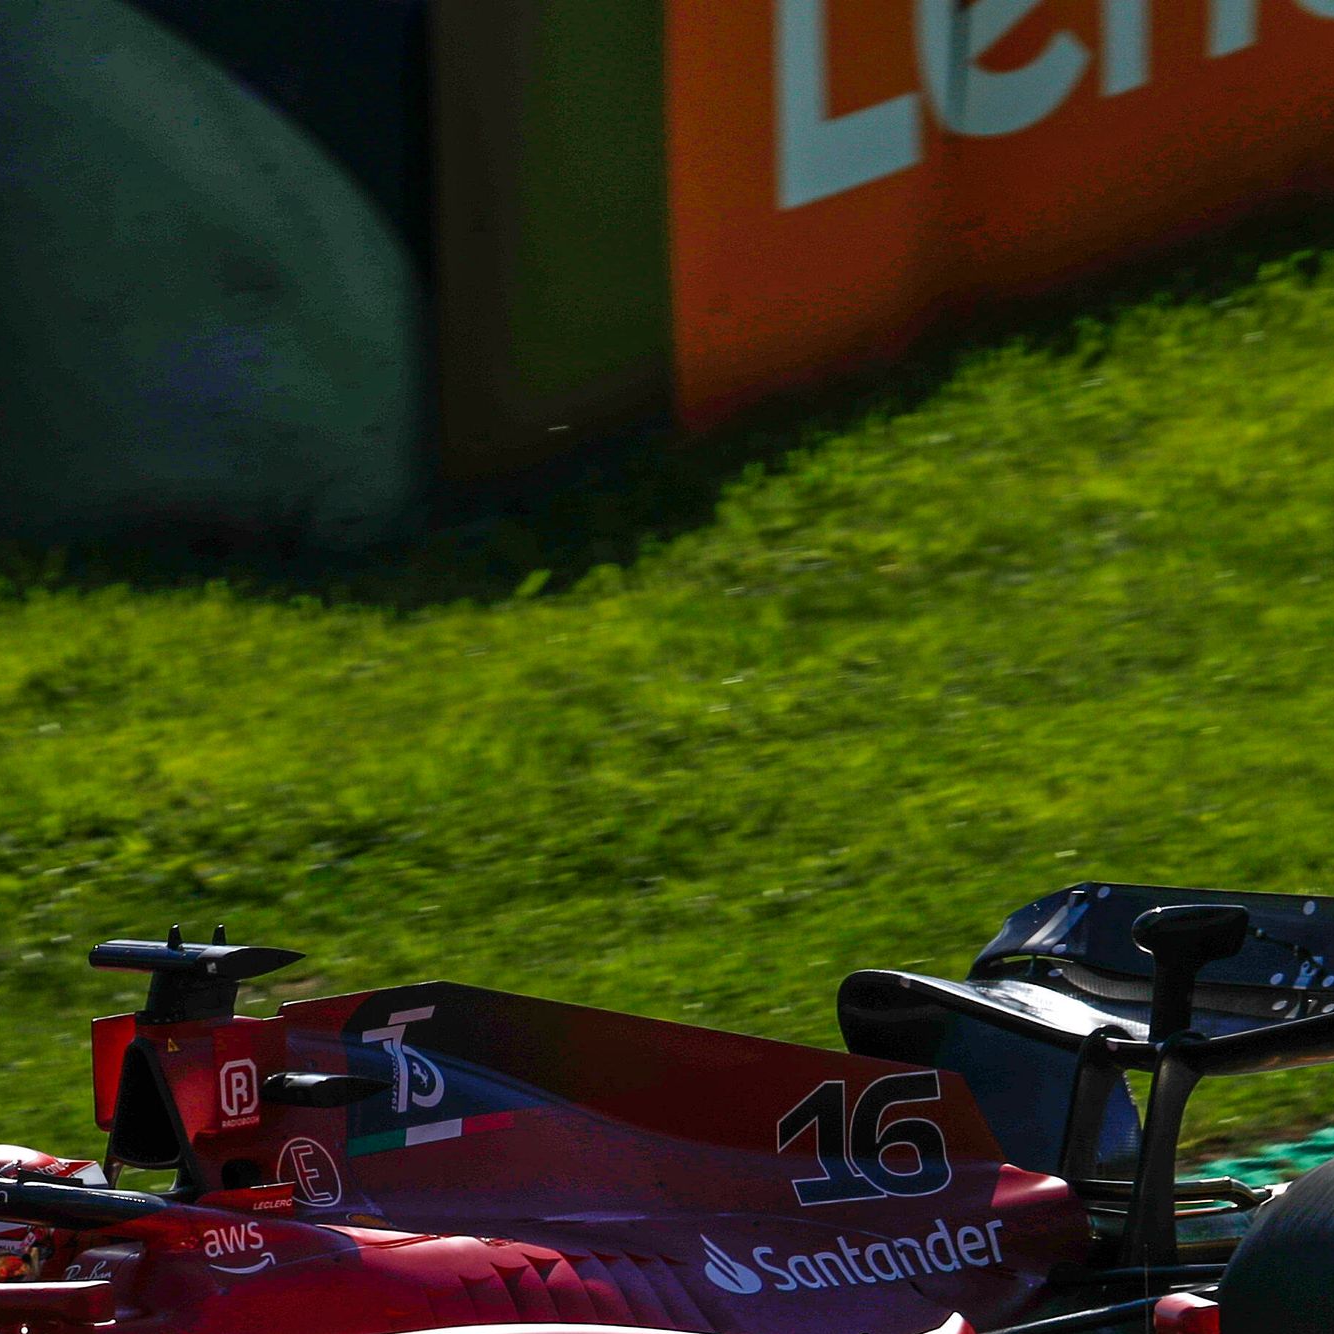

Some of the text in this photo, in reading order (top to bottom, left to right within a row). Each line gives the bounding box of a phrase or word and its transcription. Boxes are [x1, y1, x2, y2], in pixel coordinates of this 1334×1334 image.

[777, 1070, 951, 1206] 16
[253, 1198, 293, 1211] LECLERC
[203, 1221, 265, 1259] aws
[757, 1217, 1004, 1292] Santander
